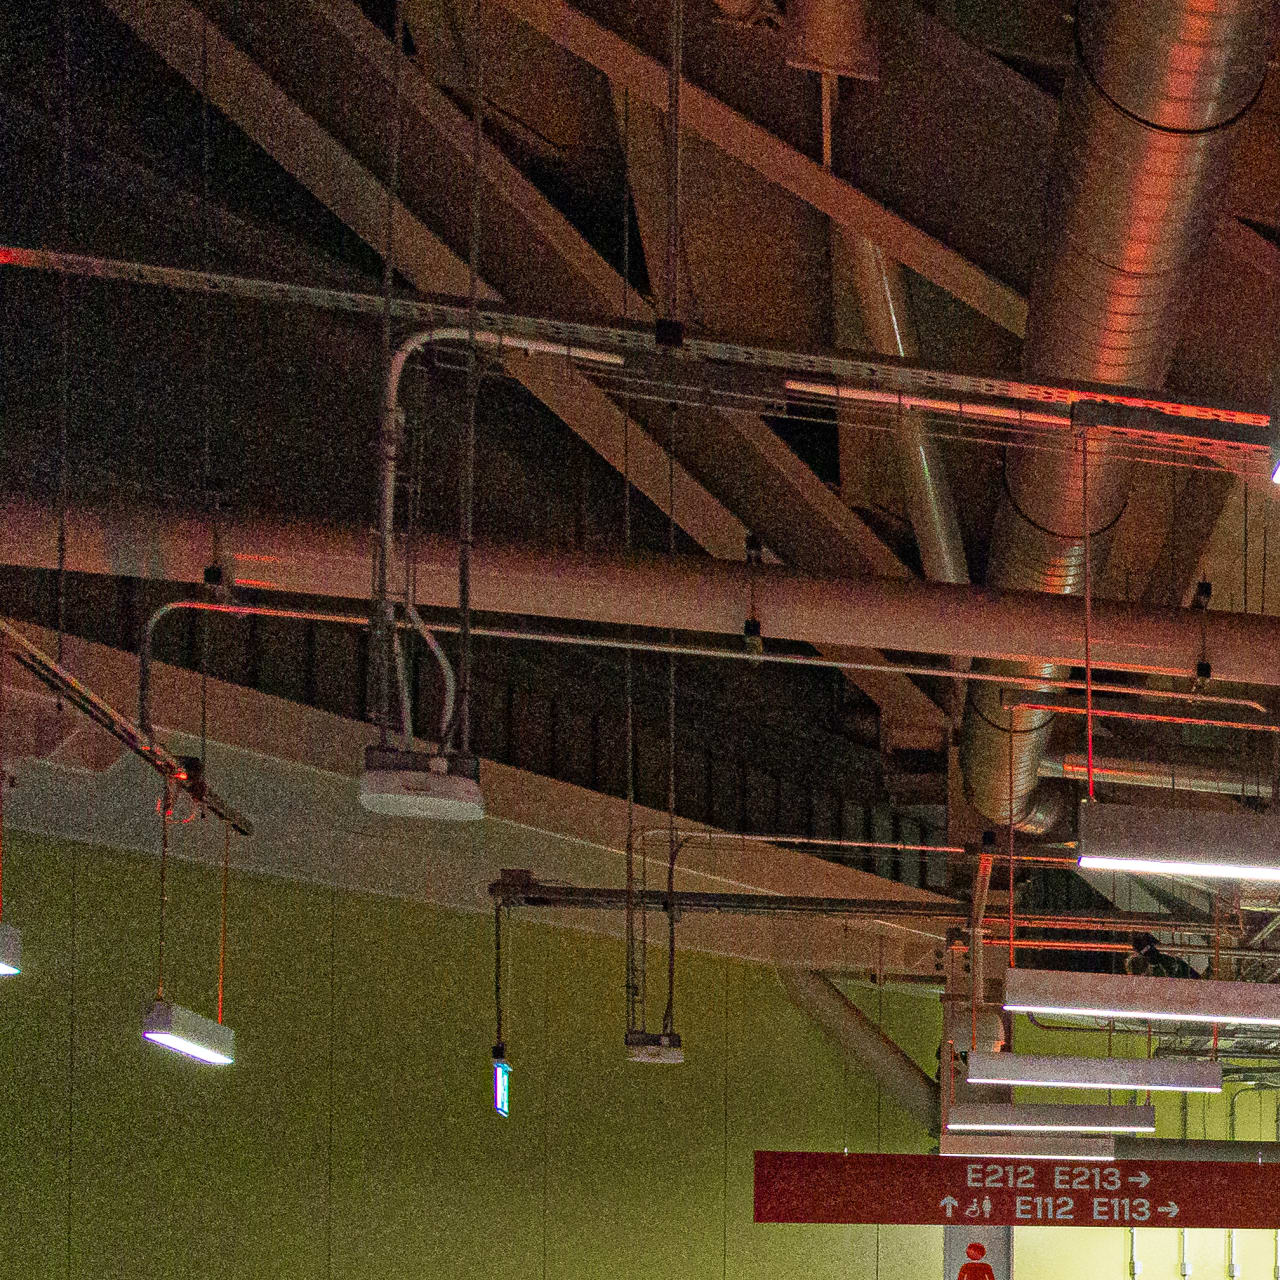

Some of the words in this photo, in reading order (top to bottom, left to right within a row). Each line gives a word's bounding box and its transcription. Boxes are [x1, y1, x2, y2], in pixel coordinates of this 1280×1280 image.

[967, 1164, 1035, 1188] E212
[1054, 1167, 1121, 1191] E213
[1016, 1196, 1074, 1219] E112
[1093, 1198, 1150, 1221] E113
